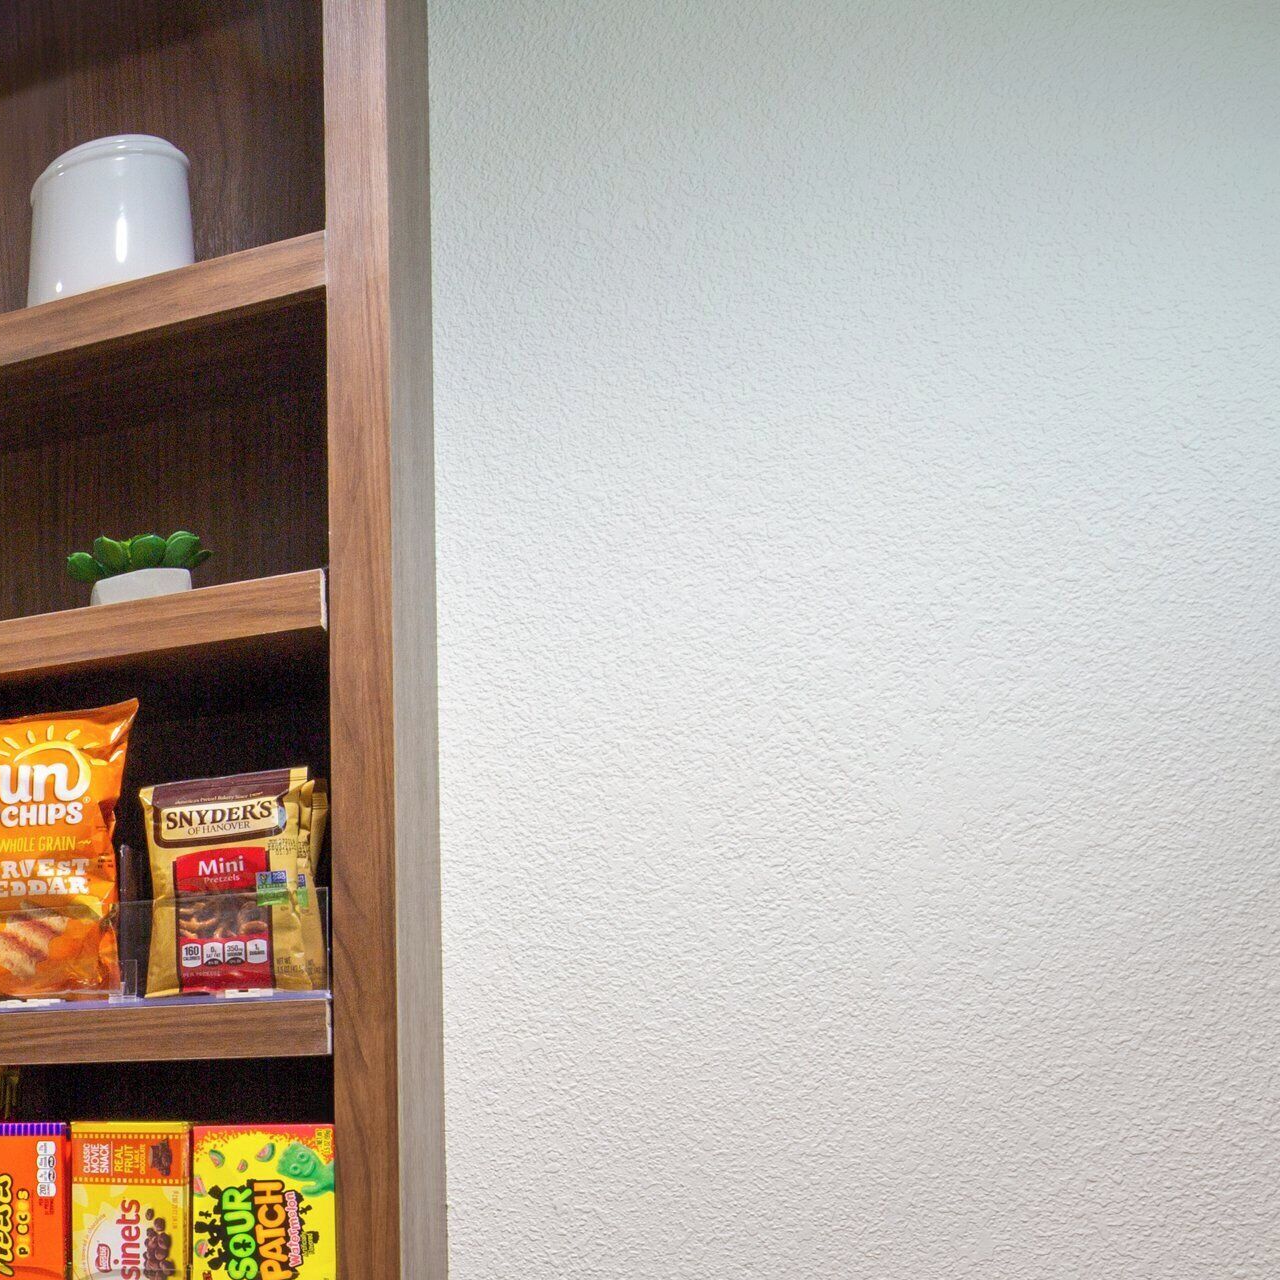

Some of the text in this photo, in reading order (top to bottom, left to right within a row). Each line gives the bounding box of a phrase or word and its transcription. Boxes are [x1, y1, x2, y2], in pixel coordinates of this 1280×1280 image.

[0, 804, 84, 827] CHIPS
[166, 800, 273, 830] SNYDER'S
[187, 820, 251, 836] OF HANOVER
[37, 835, 77, 851] GRAIN
[198, 856, 244, 876] Mini
[203, 874, 240, 884] Pretzels
[184, 945, 200, 956] 160
[82, 1143, 90, 1174] CLASSIC
[91, 1143, 100, 1173] MOVIE
[99, 1143, 109, 1174] SNACK
[114, 1145, 124, 1172] REAL
[124, 1144, 133, 1174] FRUIT
[222, 1186, 258, 1280] SOUR
[285, 1191, 302, 1268] Watermelon
